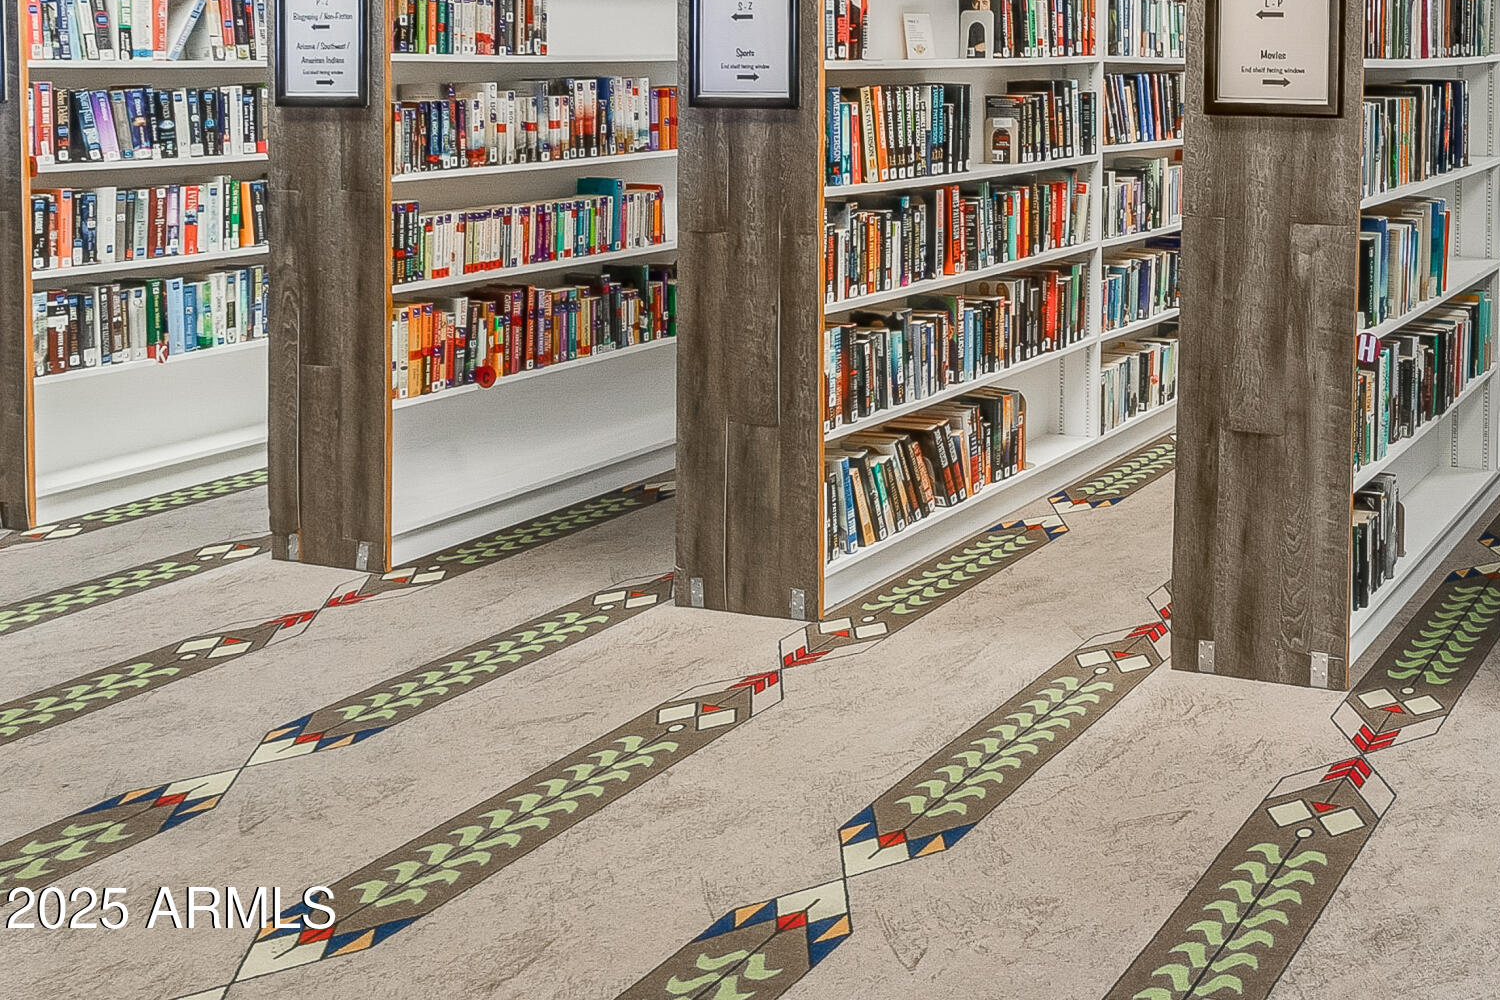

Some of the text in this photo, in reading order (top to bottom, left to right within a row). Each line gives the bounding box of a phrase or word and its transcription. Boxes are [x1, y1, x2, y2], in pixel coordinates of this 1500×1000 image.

[736, 48, 755, 58] Sports
[1260, 50, 1287, 60] Movies
[831, 91, 841, 162] JAMES PATTERSON
[866, 114, 875, 157] PATTERSON
[156, 343, 168, 363] K
[1358, 334, 1377, 362] H
